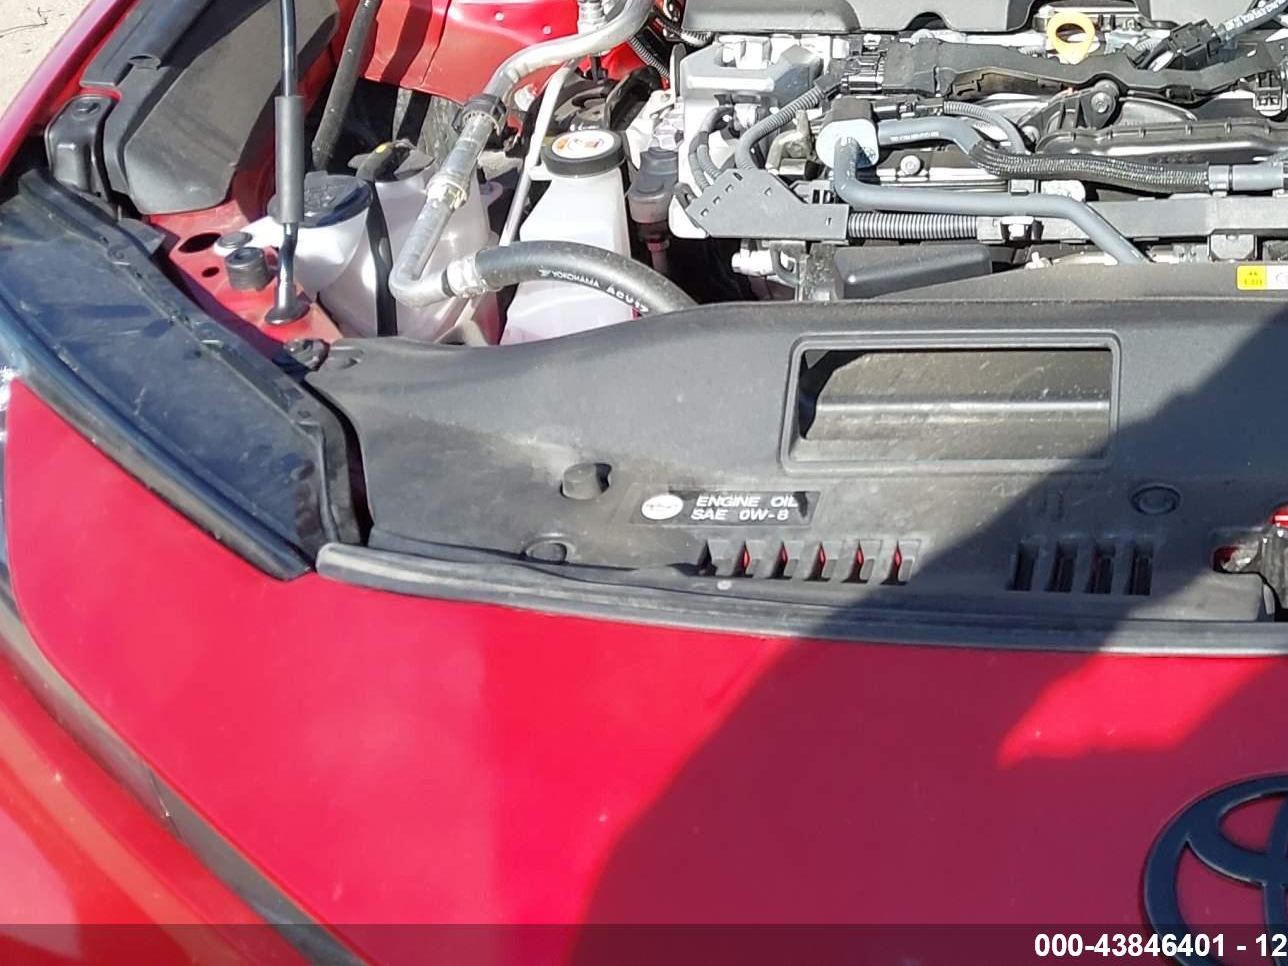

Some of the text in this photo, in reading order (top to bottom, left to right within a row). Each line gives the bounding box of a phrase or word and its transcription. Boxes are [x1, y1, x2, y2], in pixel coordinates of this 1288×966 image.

[551, 270, 600, 288] YOKOHAMA
[696, 495, 799, 507] ENGINE OIL
[690, 508, 728, 521] SAE
